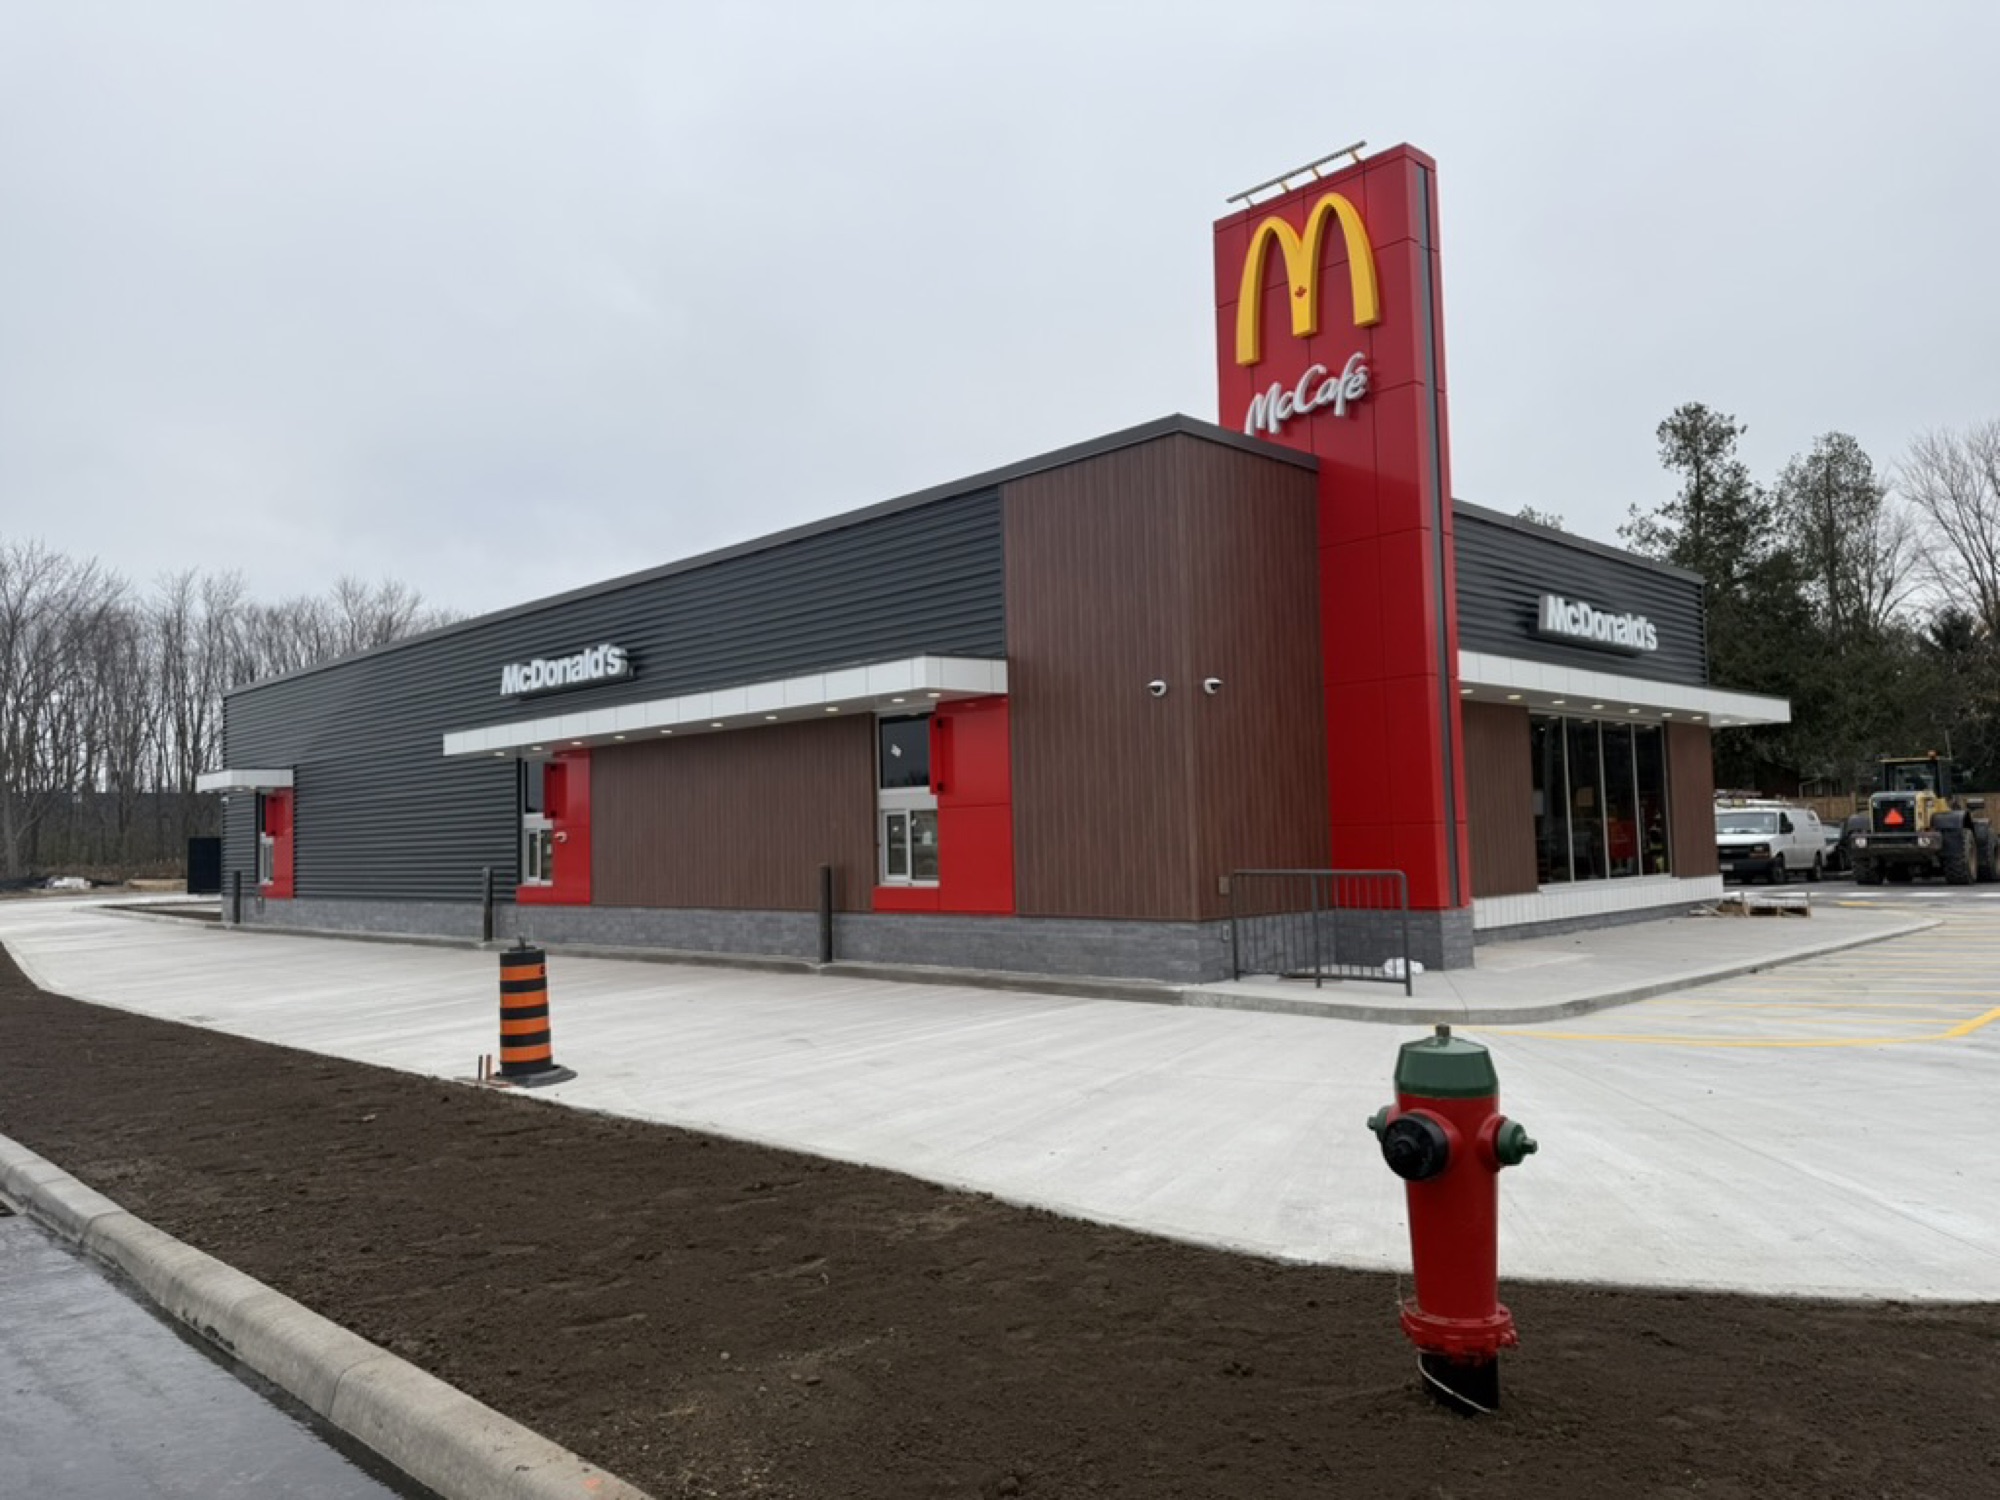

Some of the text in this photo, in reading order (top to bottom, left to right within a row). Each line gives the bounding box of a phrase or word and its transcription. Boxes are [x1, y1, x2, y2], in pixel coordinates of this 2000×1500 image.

[1245, 352, 1368, 436] McCafé
[1545, 594, 1658, 651] McDonald's
[500, 643, 626, 696] McDonald's
